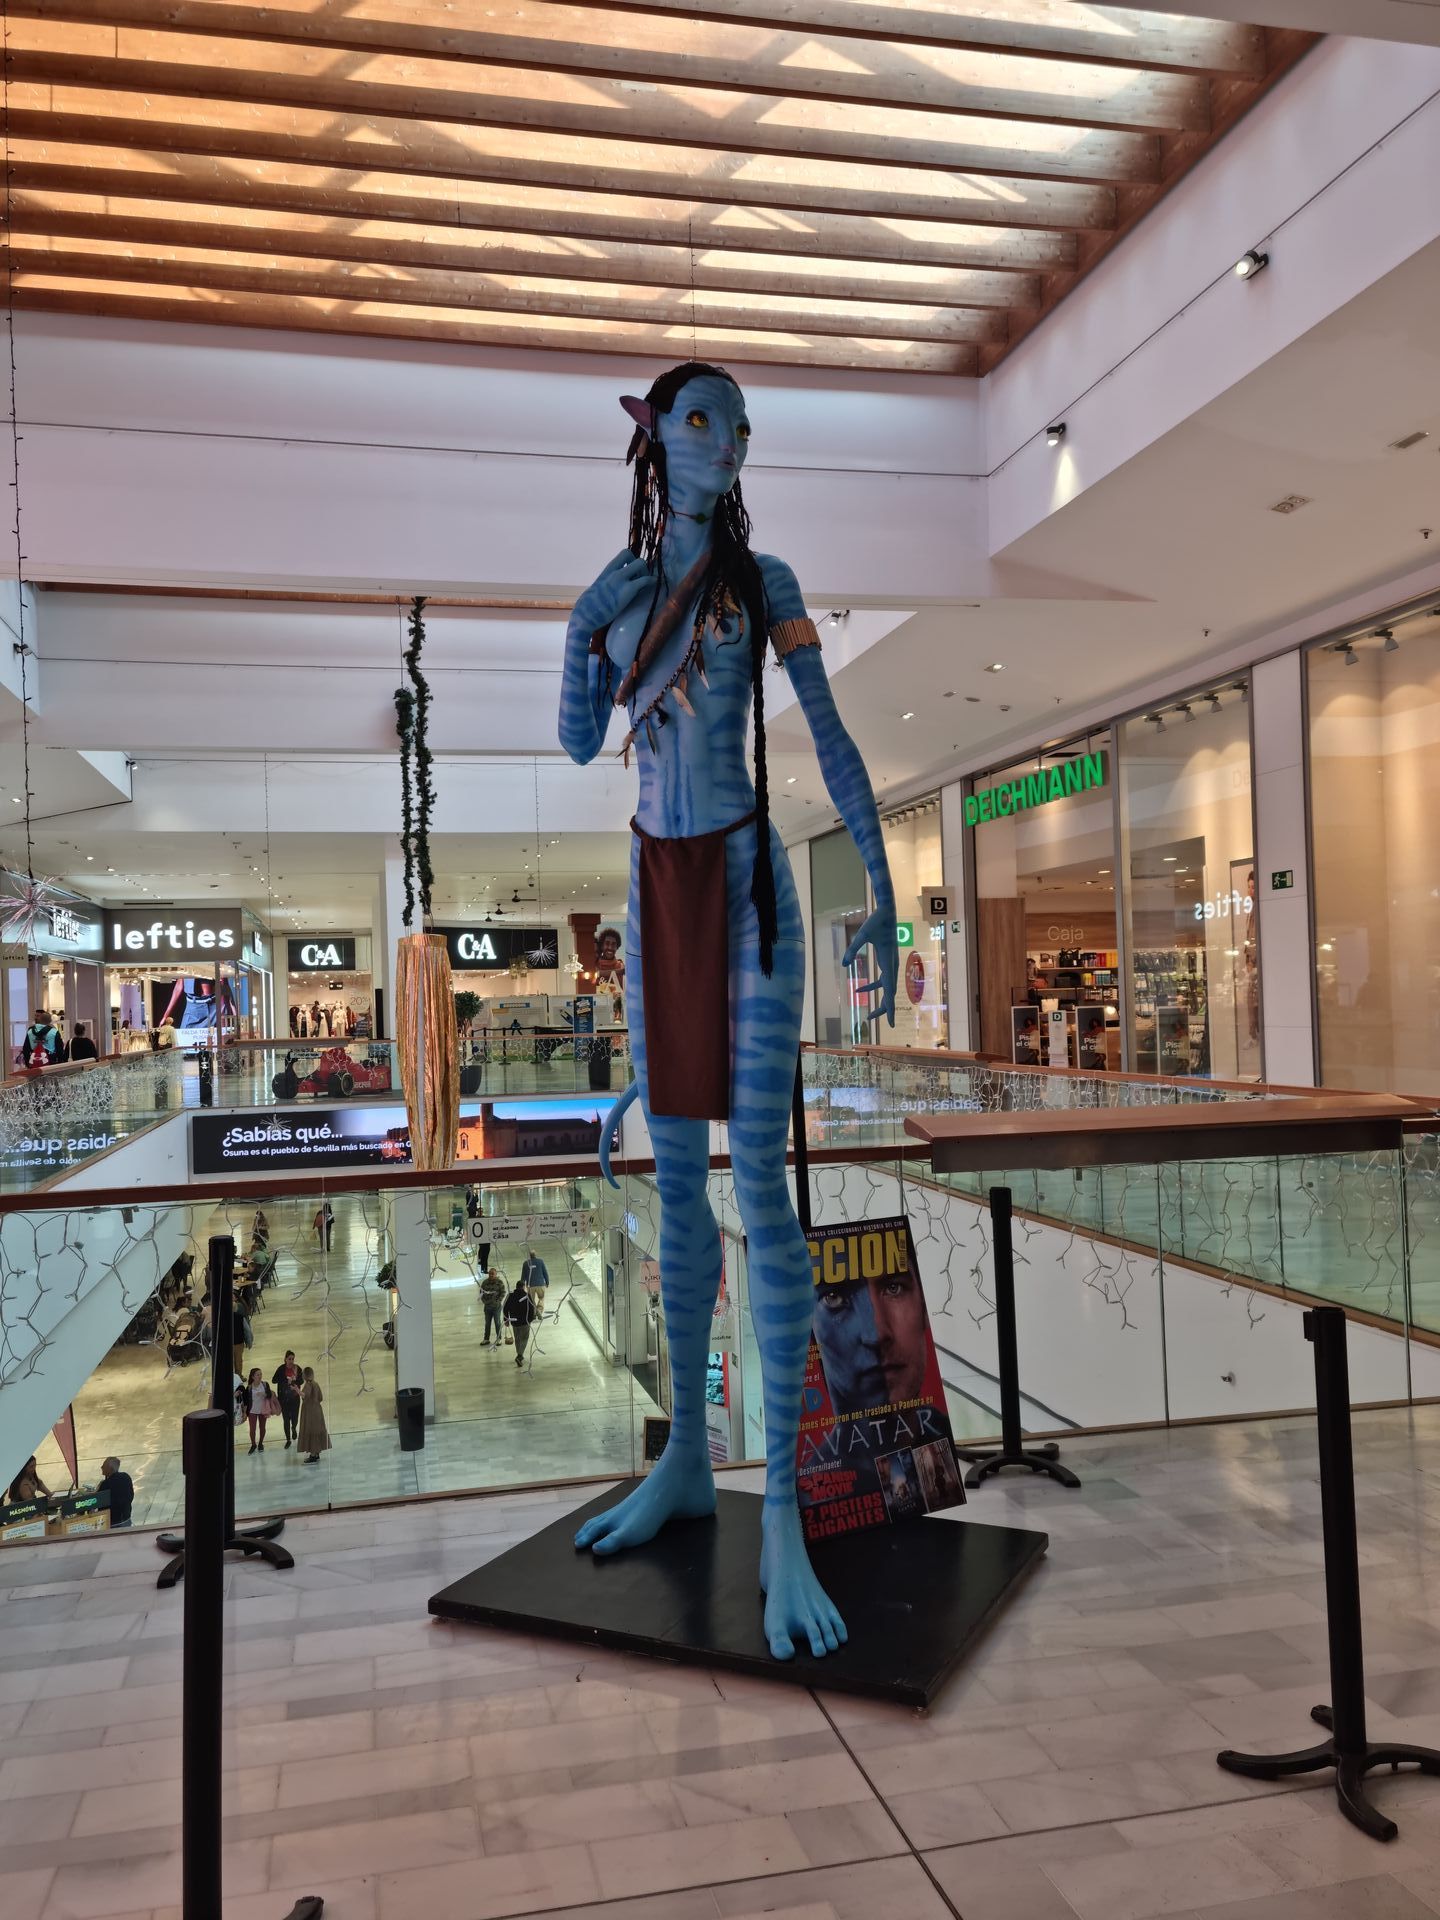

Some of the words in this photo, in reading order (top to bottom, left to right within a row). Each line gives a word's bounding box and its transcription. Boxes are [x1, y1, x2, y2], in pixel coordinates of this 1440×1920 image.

[965, 751, 1104, 828] DEICHMANN
[934, 899, 944, 910] D
[113, 921, 234, 949] lefties
[1047, 925, 1085, 943] Caja
[301, 944, 342, 966] C&A
[457, 933, 497, 960] C&A
[295, 1123, 343, 1143] qué...
[222, 1149, 249, 1157] Osuna
[261, 1147, 270, 1155] el
[271, 1146, 300, 1156] pueblo
[300, 1145, 312, 1153] de
[312, 1144, 340, 1153] Sevilla
[341, 1143, 358, 1151] más
[359, 1141, 393, 1150] buscado
[472, 1221, 484, 1238] 0
[885, 1221, 893, 1229] DEL
[893, 1220, 904, 1228] CINE
[820, 1413, 849, 1427] Cameron
[851, 1411, 863, 1420] nos
[864, 1404, 892, 1418] traslada
[898, 1398, 925, 1411] Pandora
[925, 1395, 934, 1404] en
[801, 1408, 942, 1462] AVATAR
[811, 1480, 855, 1501] MOVIE
[804, 1508, 815, 1525] 2
[819, 1491, 883, 1522] POSTERS
[808, 1506, 885, 1539] GIGANTES
